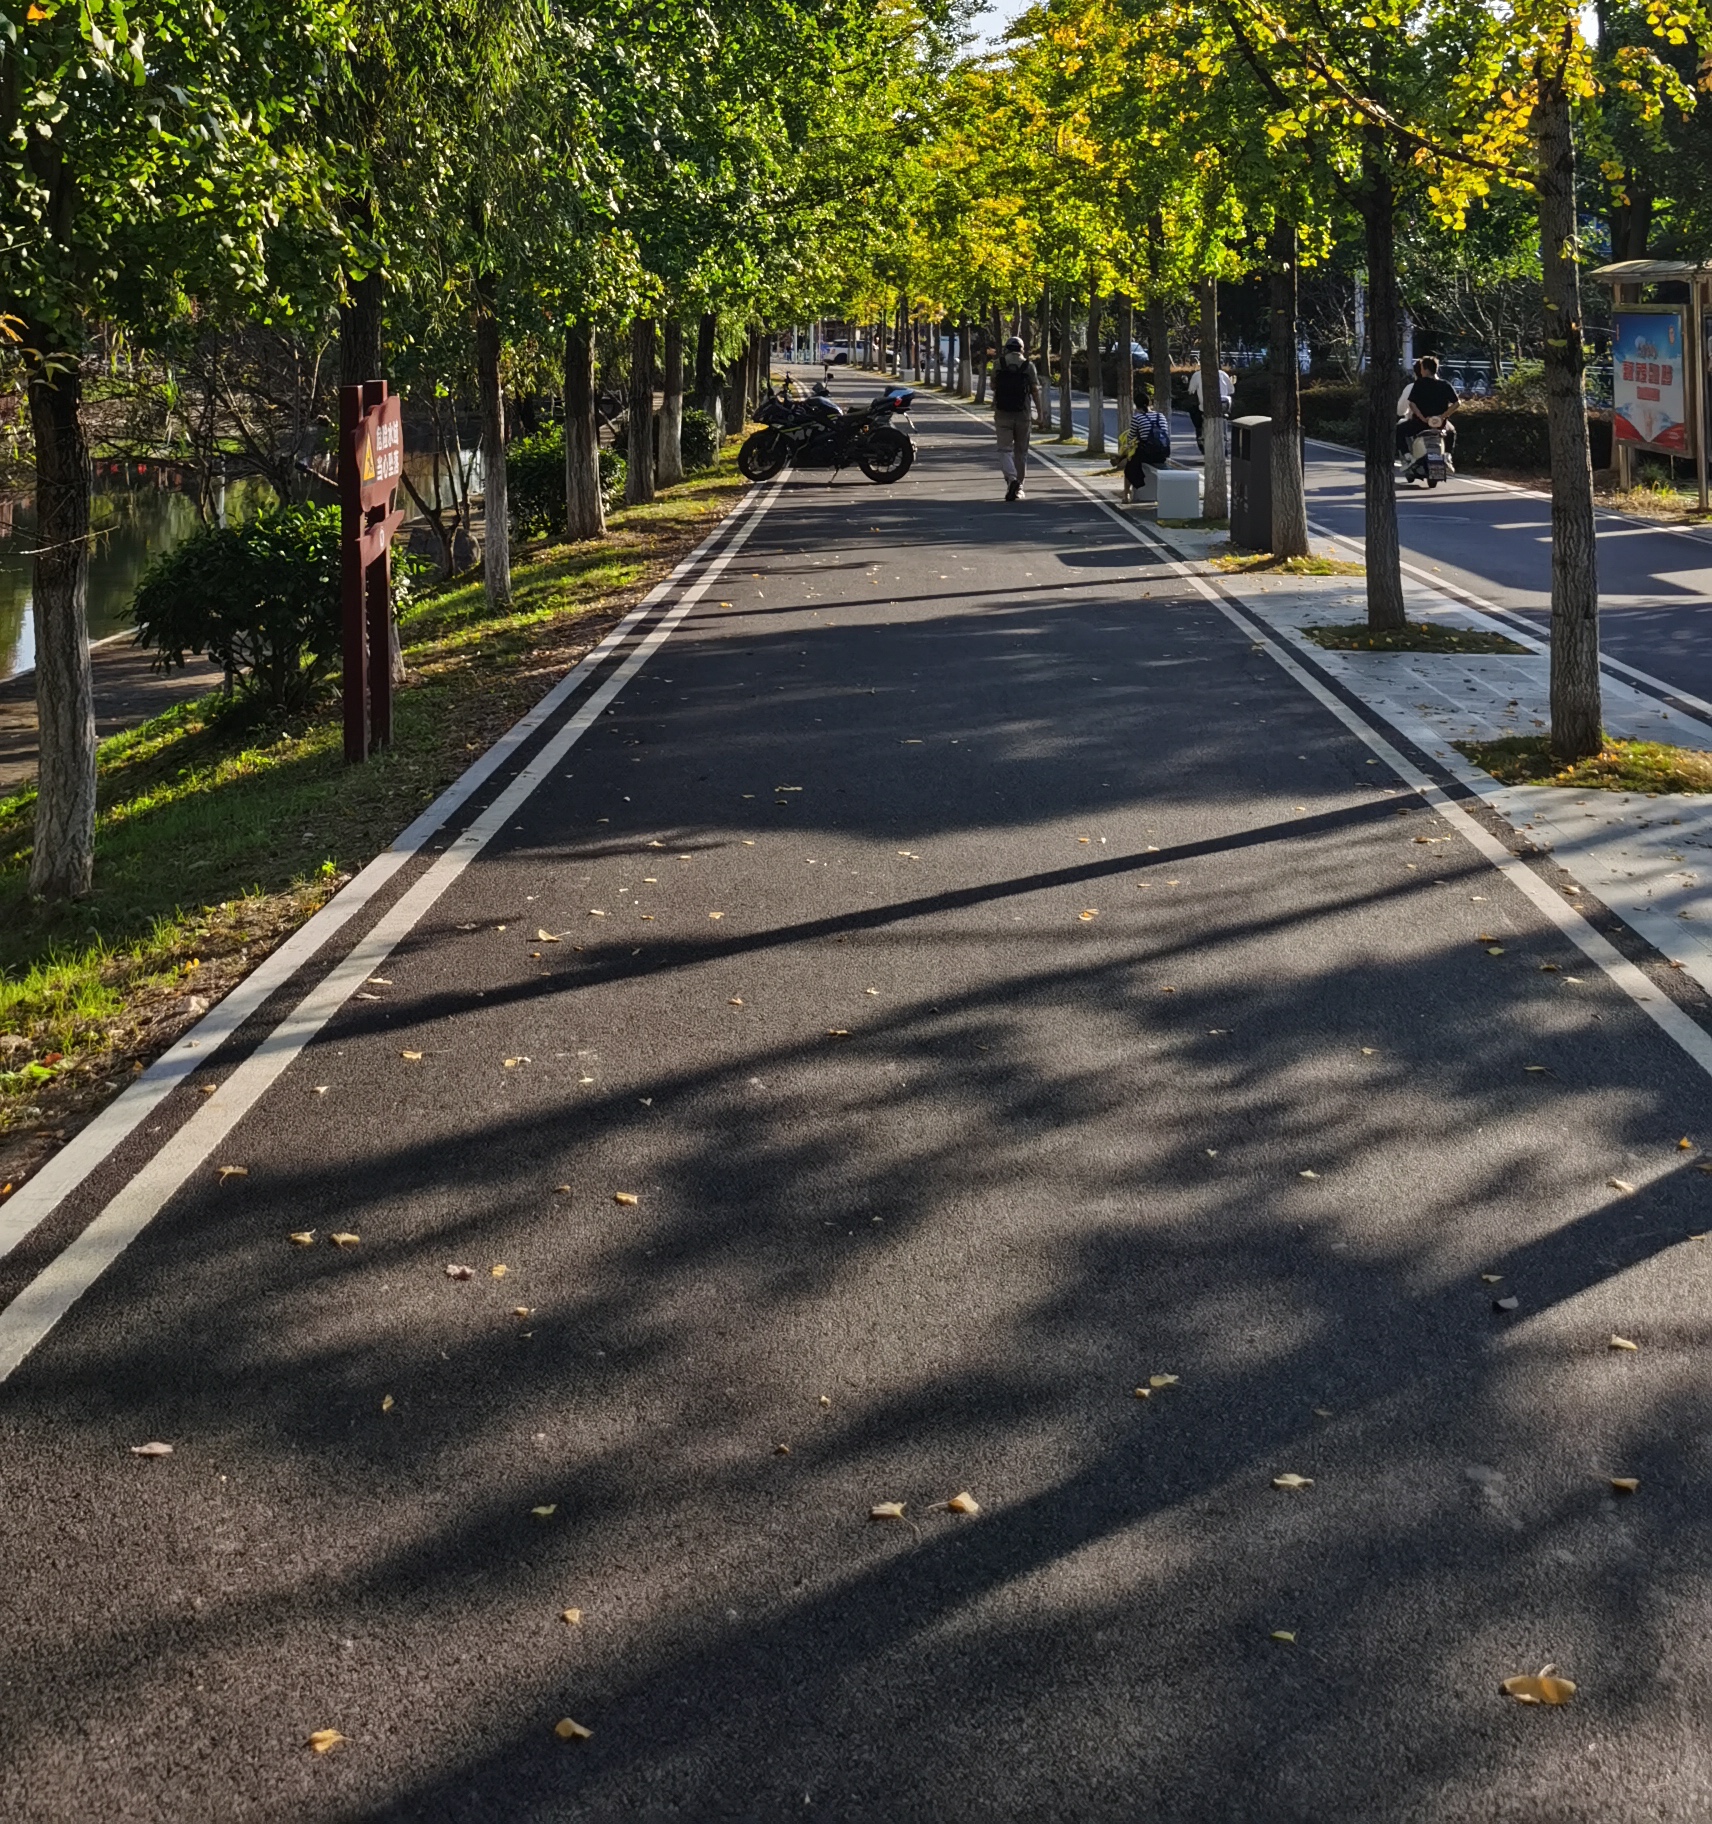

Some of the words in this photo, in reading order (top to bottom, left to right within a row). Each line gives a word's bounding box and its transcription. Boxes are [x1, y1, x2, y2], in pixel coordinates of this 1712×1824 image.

[376, 420, 399, 451] 危险水域
[376, 450, 399, 480] 当心坠落
